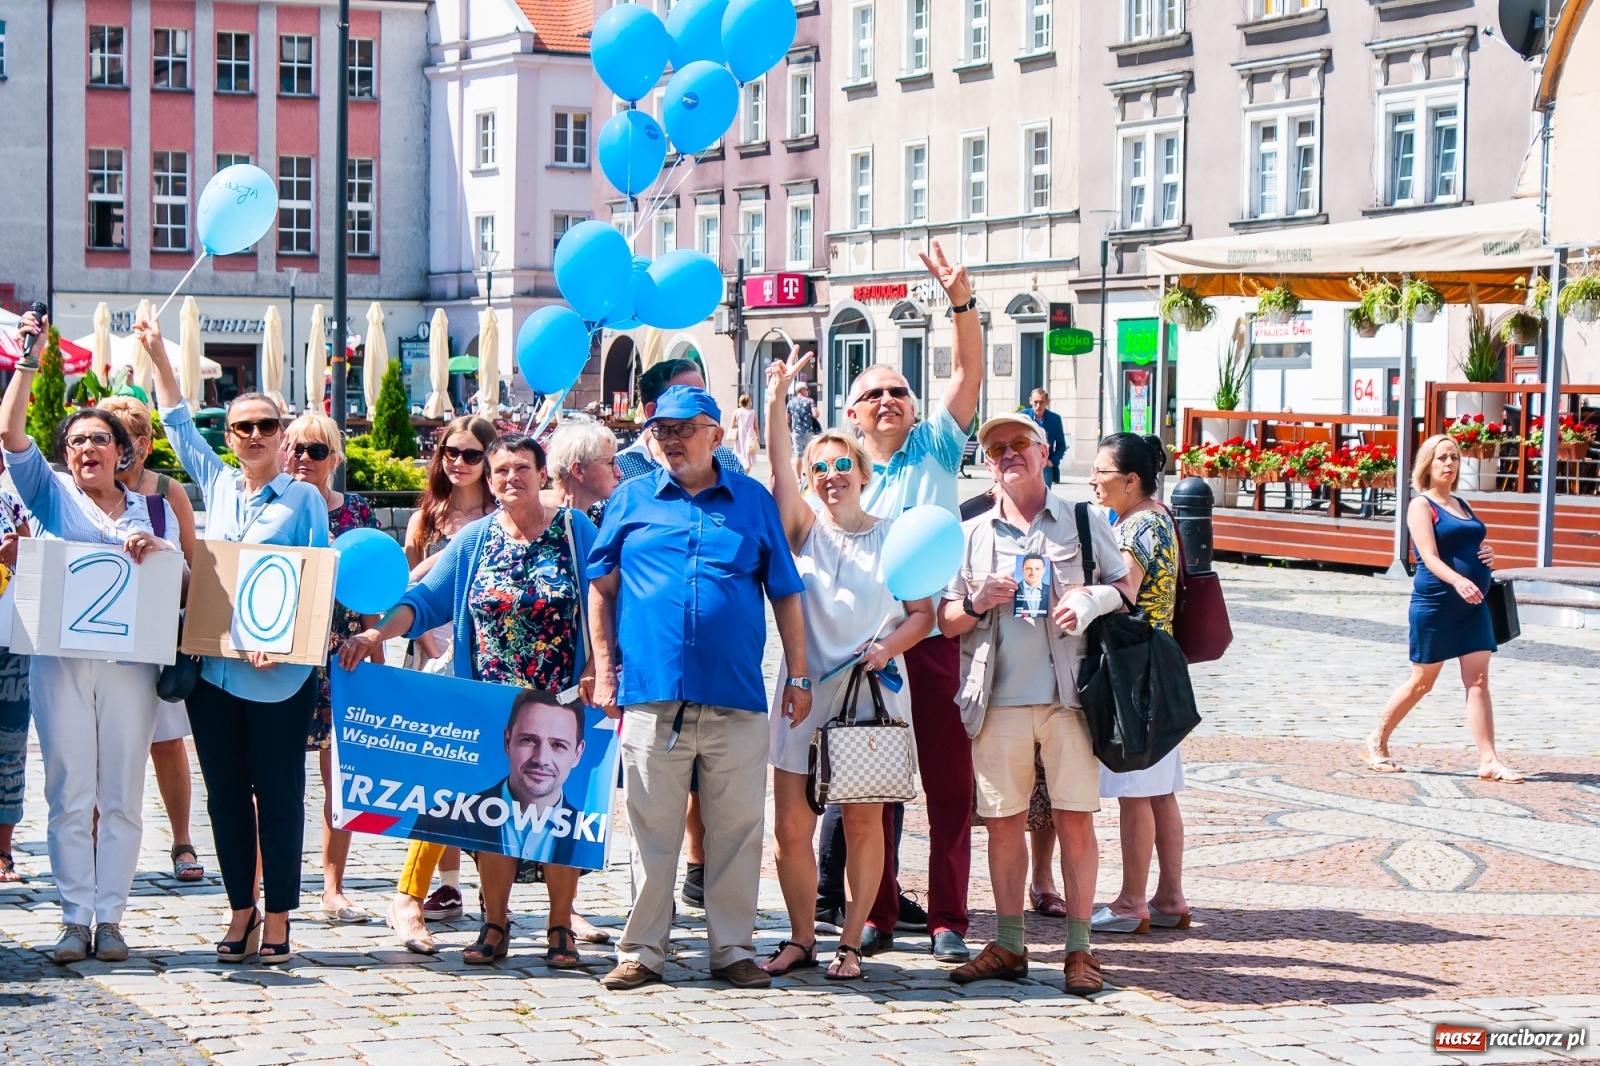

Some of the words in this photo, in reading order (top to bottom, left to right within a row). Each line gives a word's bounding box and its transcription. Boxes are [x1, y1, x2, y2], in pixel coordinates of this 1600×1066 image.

[1227, 249, 1258, 263] BROWAR
[1482, 241, 1521, 256] BROWAR
[783, 278, 799, 299] T
[1054, 334, 1090, 346] żabka
[68, 551, 131, 637] 2
[344, 706, 387, 729] Silny
[390, 714, 481, 741] Prezydent
[342, 726, 418, 753] Wspólna
[421, 741, 480, 763] Polska
